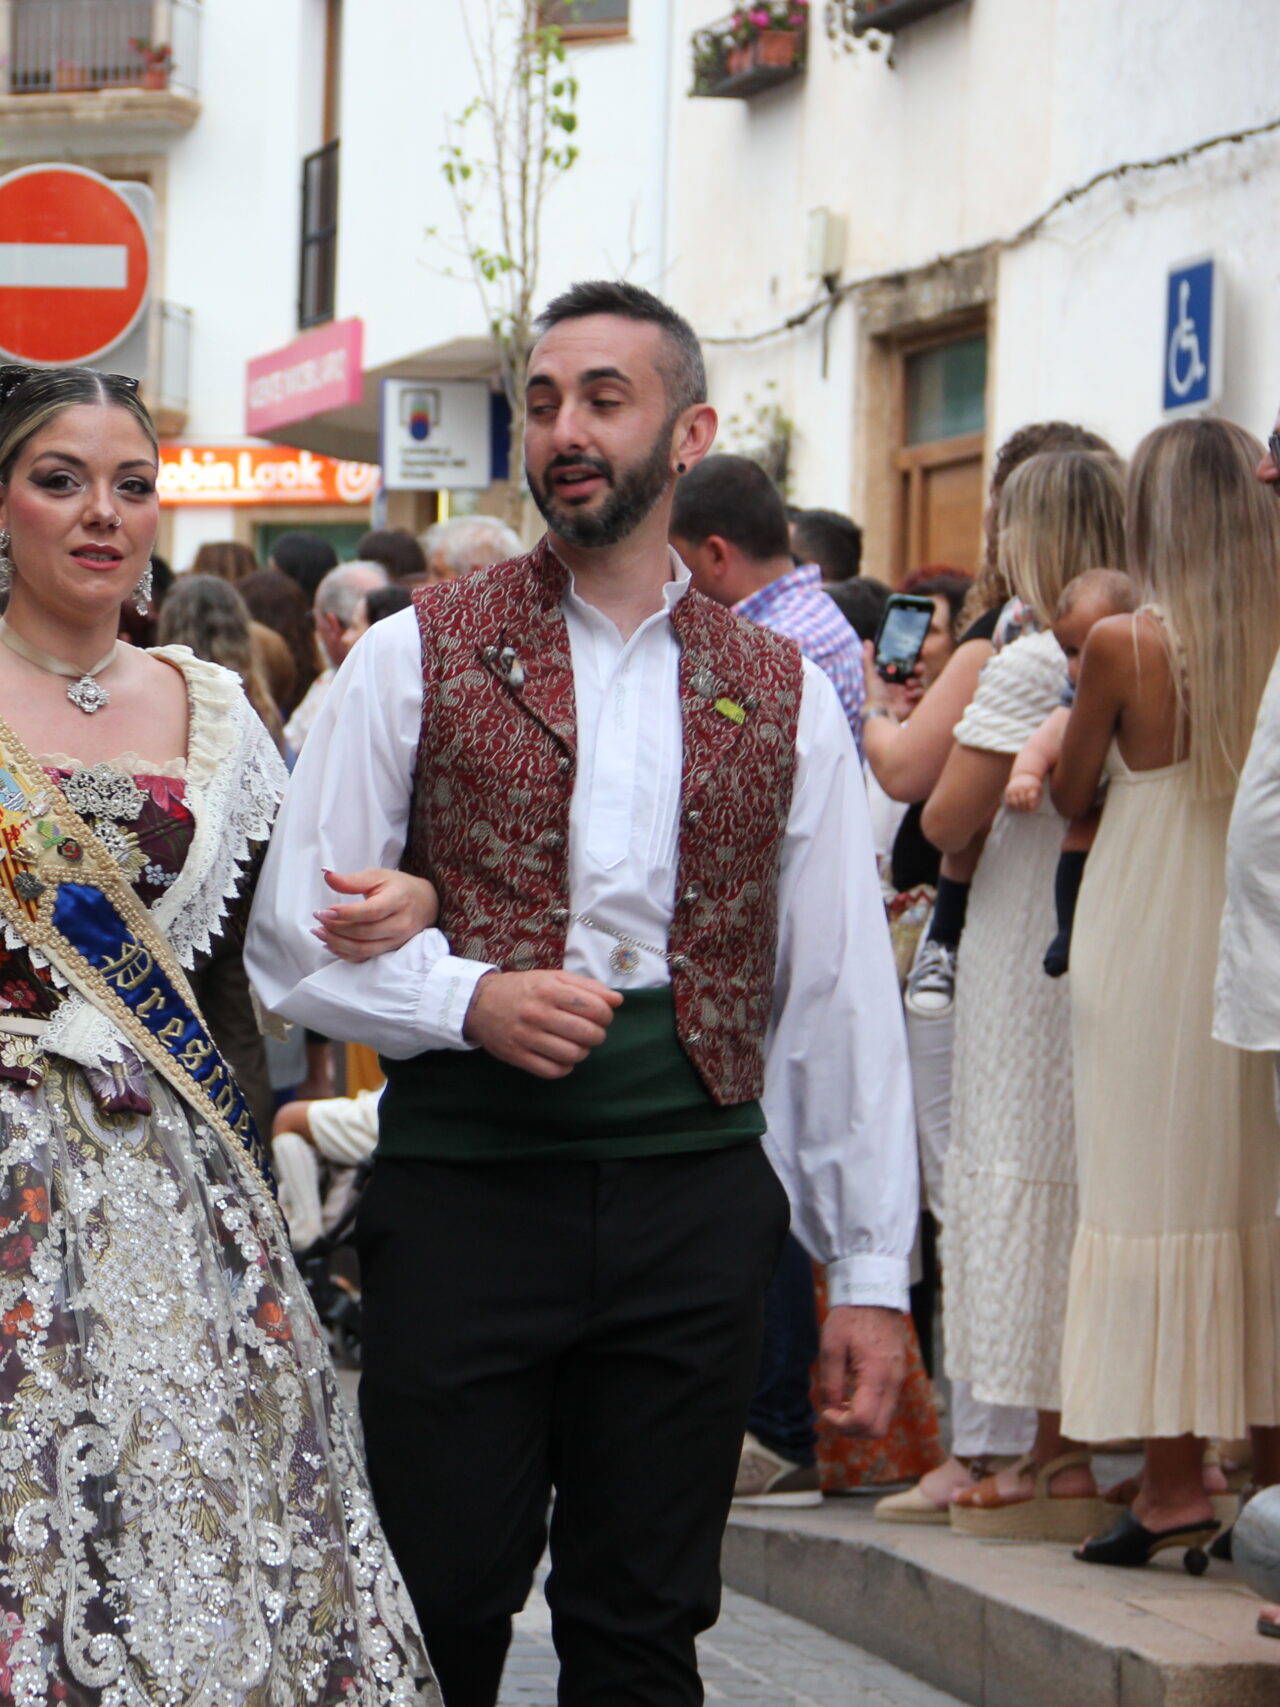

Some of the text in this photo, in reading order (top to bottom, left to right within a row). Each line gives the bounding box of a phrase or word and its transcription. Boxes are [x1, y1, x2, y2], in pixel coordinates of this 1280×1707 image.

[157, 448, 324, 489] obin Look
[99, 928, 275, 1190] Presiden
